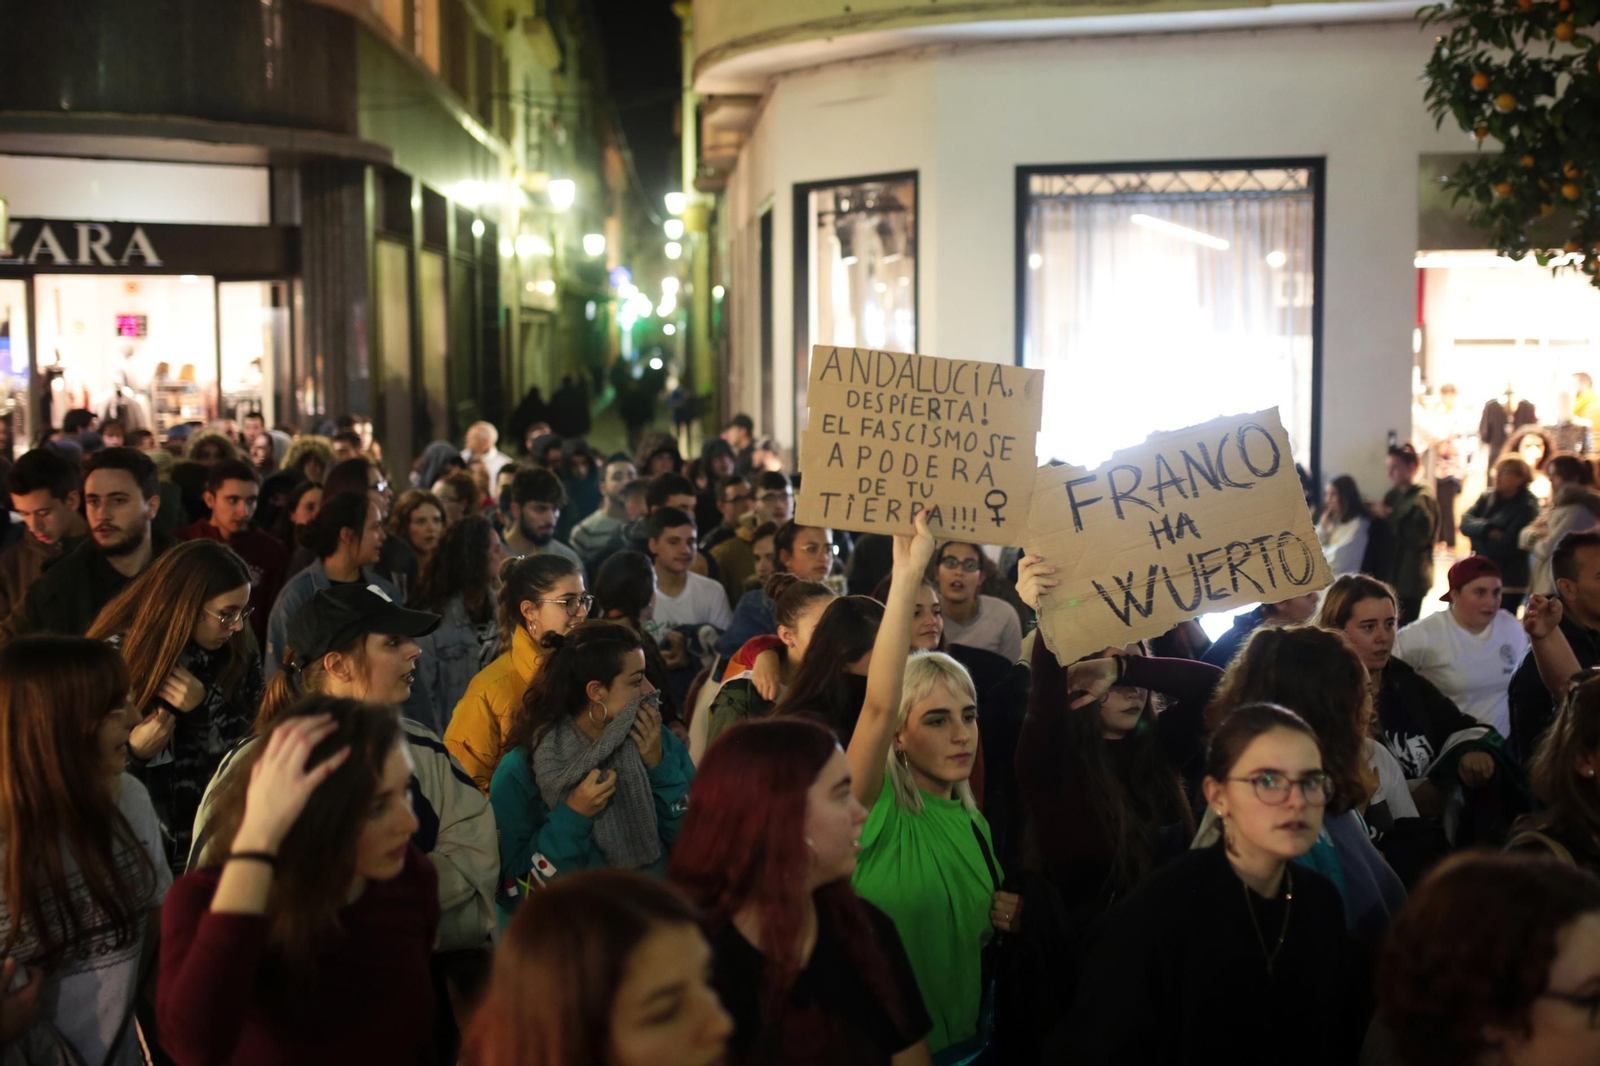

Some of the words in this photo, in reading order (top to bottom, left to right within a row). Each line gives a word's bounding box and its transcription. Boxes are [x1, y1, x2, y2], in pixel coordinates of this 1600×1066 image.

[819, 346, 1014, 398] ANDALUCÍA,
[822, 414, 850, 435] EL
[860, 416, 978, 452] FASCISMO
[983, 434, 1016, 461] SE
[858, 477, 887, 496] DE
[906, 481, 934, 499] TU
[1064, 421, 1281, 533] FRANCO
[1148, 512, 1202, 550] HA
[1090, 531, 1315, 627] WUERTO
